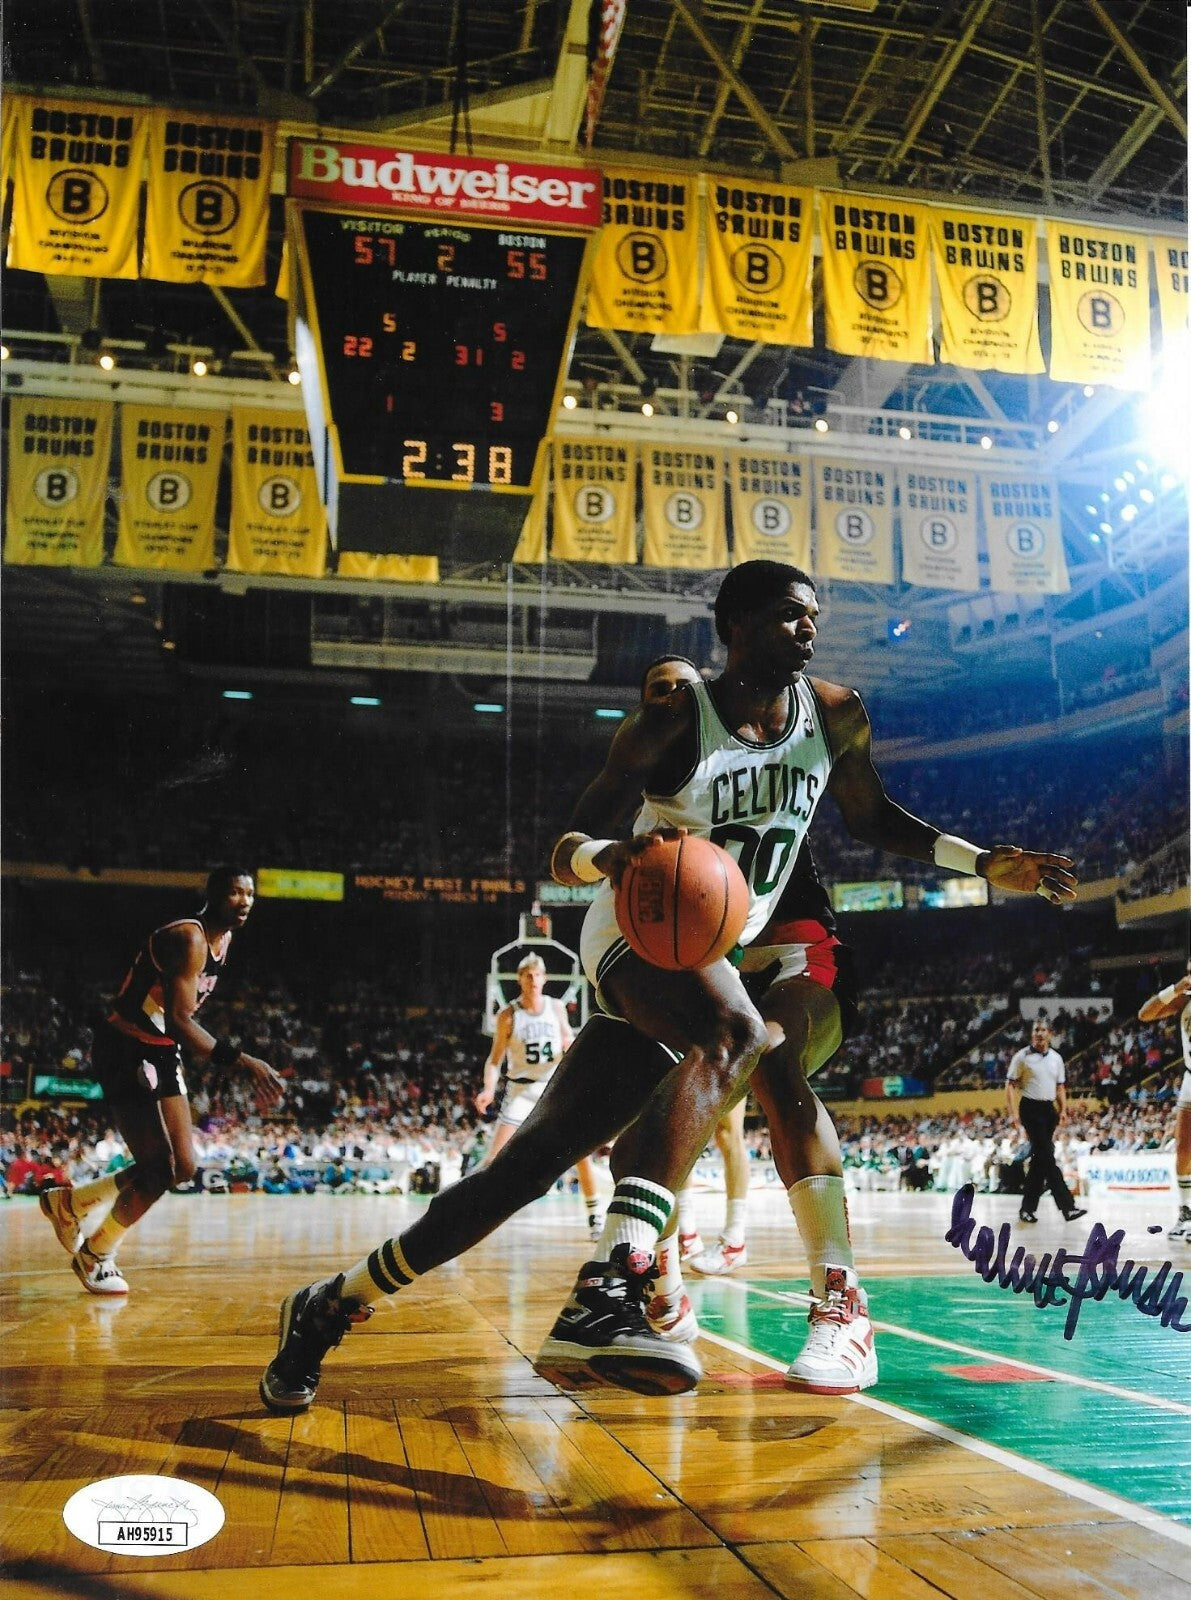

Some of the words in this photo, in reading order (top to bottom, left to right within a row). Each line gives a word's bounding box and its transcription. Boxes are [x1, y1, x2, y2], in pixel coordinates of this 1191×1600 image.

[32, 108, 133, 141] BOSTON
[165, 121, 262, 154] BOSTON
[31, 136, 130, 167] BRUINS
[164, 148, 261, 180] BRUINS
[299, 145, 596, 208] Budweiser
[63, 177, 91, 214] B
[195, 190, 223, 225] B
[716, 186, 802, 217] BOSTON
[340, 219, 405, 236] VISITOR
[717, 211, 800, 242] BRUINS
[834, 205, 915, 235] BOSTON
[498, 234, 547, 249] BOSTON
[836, 230, 915, 259] BRUINS
[943, 221, 1023, 248] BOSTON
[355, 235, 396, 266] 57
[437, 245, 455, 272] 2
[631, 241, 655, 274] B
[946, 246, 1024, 272] BRUINS
[1060, 235, 1136, 264] BOSTON
[507, 250, 547, 281] 55
[747, 252, 769, 284] B
[1062, 260, 1137, 288] BRUINS
[392, 271, 437, 285] PLAYER
[446, 275, 498, 291] PENALTY
[866, 268, 888, 300] B
[977, 283, 998, 313] B
[383, 312, 397, 333] 5
[1091, 298, 1112, 328] B
[493, 322, 507, 342] 5
[343, 336, 373, 357] 22
[402, 341, 416, 361] 2
[511, 351, 526, 370] 2
[490, 402, 504, 422] 3
[24, 414, 97, 435] BOSTON
[137, 420, 210, 442] BOSTON
[24, 436, 95, 457] BRUINS
[136, 442, 207, 464] BRUINS
[562, 443, 627, 463] BOSTON
[403, 440, 512, 484] 2:38
[653, 450, 715, 470] BOSTON
[739, 457, 801, 477] BOSTON
[562, 463, 626, 482] BRUINS
[653, 471, 715, 489] BRUINS
[823, 466, 885, 488] BOSTON
[907, 473, 968, 494] BOSTON
[47, 473, 67, 501] B
[160, 479, 178, 504] B
[271, 483, 290, 509] B
[740, 476, 801, 497] BRUINS
[824, 485, 885, 506] BRUINS
[990, 481, 1051, 500] BOSTON
[586, 492, 603, 517] B
[677, 499, 694, 523] B
[908, 494, 968, 514] BRUINS
[992, 501, 1052, 519] BRUINS
[764, 505, 780, 530] B
[847, 514, 864, 538] B
[931, 522, 947, 545] B
[1017, 528, 1034, 552] B
[711, 763, 818, 826] CELTICS
[526, 1041, 554, 1065] 54
